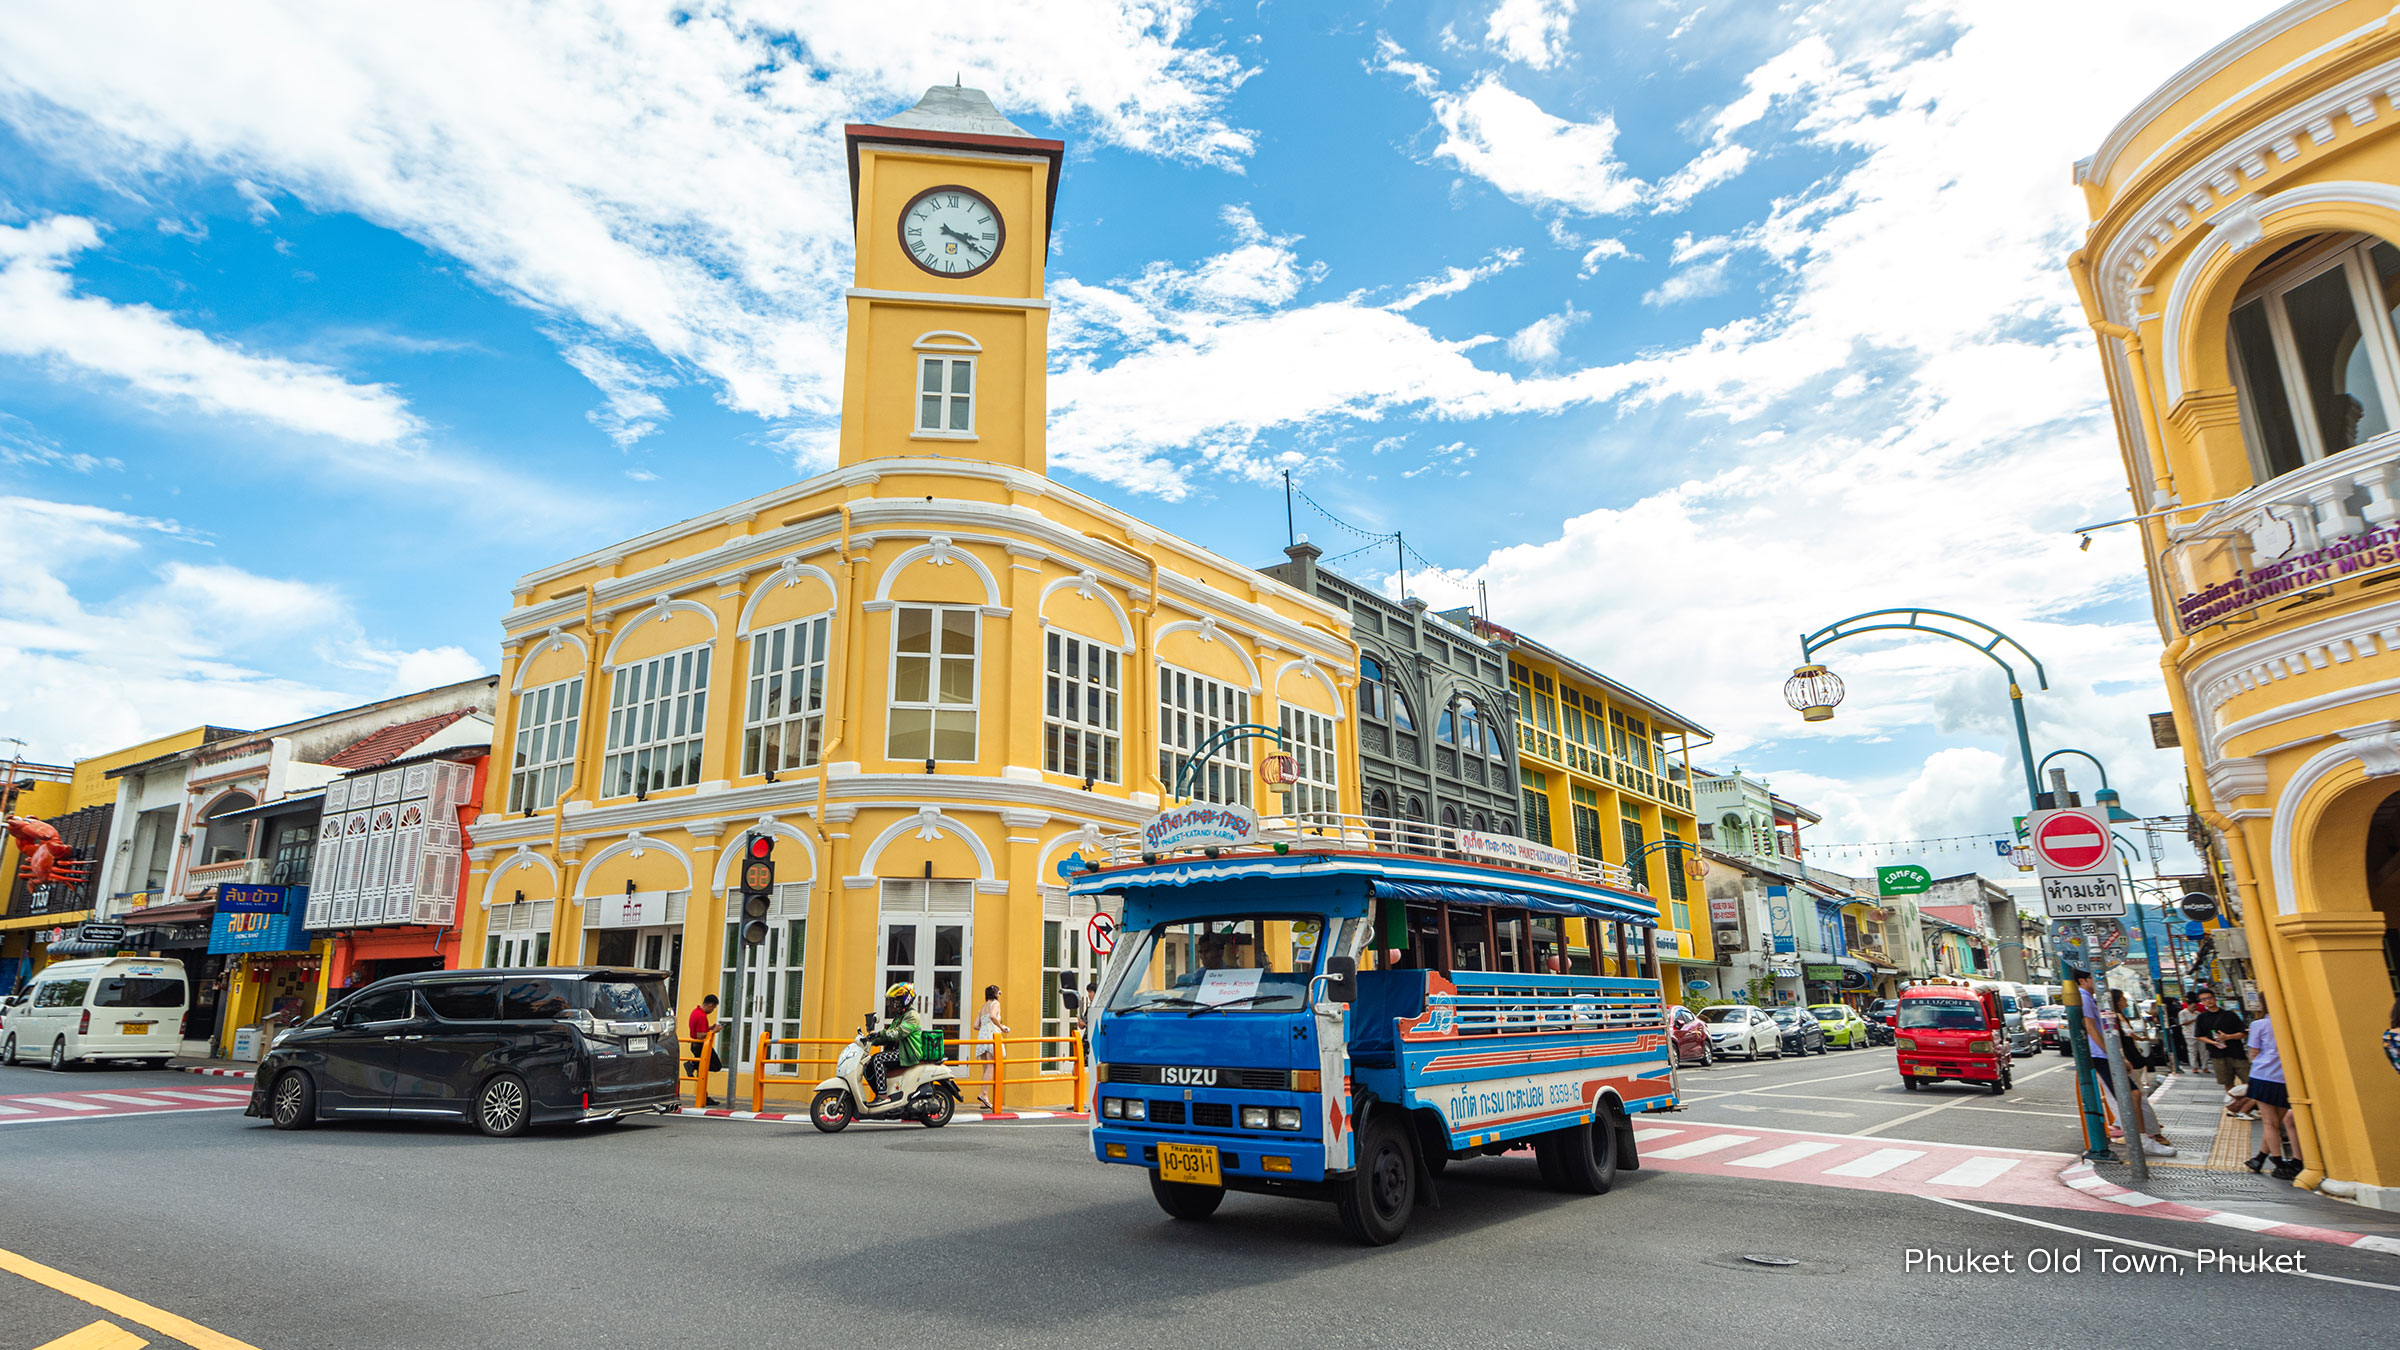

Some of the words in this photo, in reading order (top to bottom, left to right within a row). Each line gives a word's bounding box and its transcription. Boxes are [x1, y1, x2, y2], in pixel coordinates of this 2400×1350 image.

[927, 197, 942, 212] XI
[947, 195, 959, 208] XII
[913, 210, 928, 221] X
[982, 232, 995, 241] III
[2183, 563, 2332, 630] PERANAKANNITAT
[748, 866, 769, 887] 32
[1884, 870, 1924, 884] COMFEE
[2047, 877, 2117, 898] ห้ามเข้า
[2057, 904, 2072, 912] NO
[2076, 903, 2112, 912] ENTRY
[1161, 1067, 1217, 1086] ISUZU
[1479, 1091, 1504, 1116] กะรน
[1549, 1082, 1580, 1105] 8359-15
[1170, 1145, 1203, 1154] THAILAND
